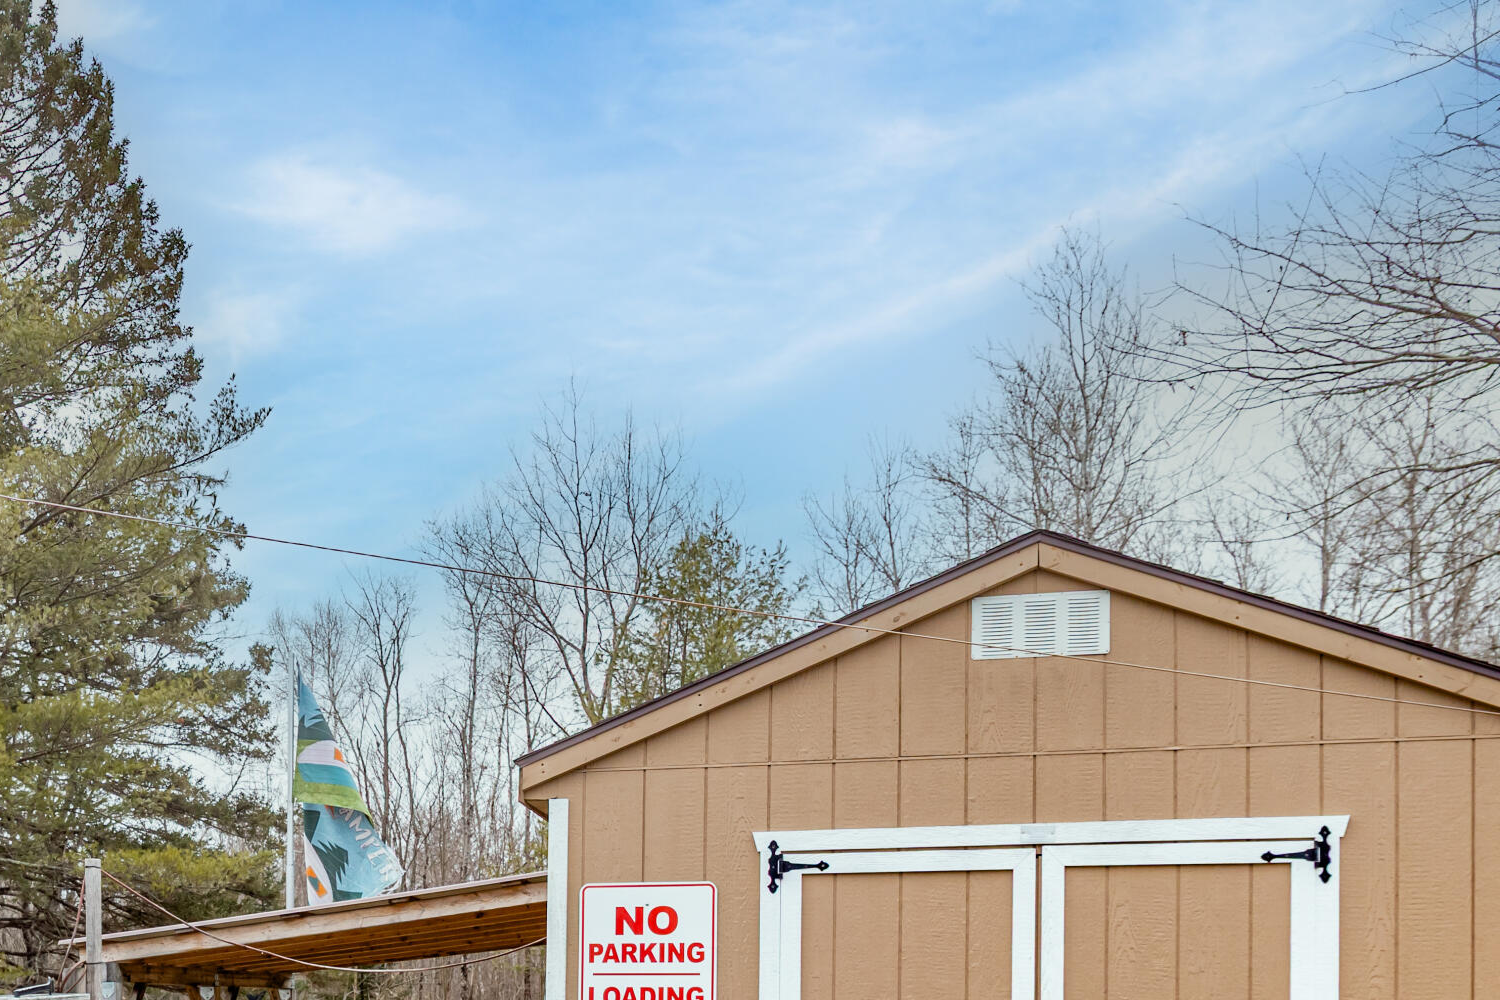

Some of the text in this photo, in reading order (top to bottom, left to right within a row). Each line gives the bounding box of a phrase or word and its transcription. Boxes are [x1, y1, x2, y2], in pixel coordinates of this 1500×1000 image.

[338, 807, 395, 882] AMPER
[615, 905, 678, 936] NO
[588, 942, 706, 964] PARKING
